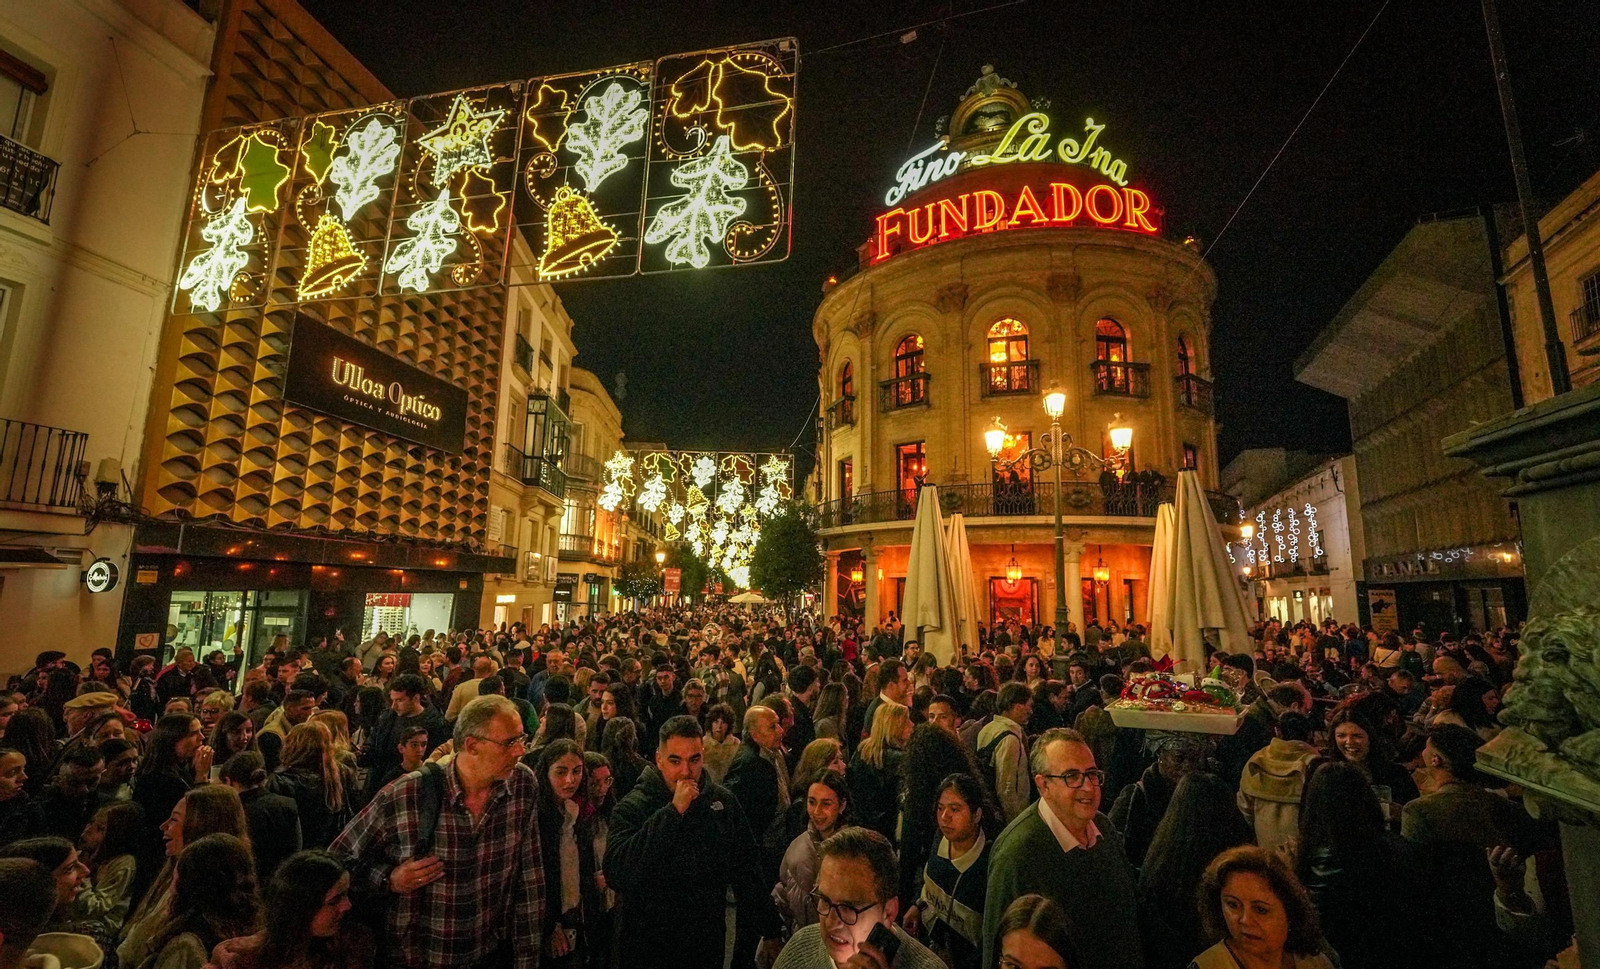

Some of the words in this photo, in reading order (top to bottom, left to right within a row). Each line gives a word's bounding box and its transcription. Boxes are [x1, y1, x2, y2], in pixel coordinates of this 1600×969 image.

[885, 140, 967, 206] Fino
[971, 112, 1053, 165] La
[875, 182, 1158, 260] FUNDADOR
[331, 355, 386, 400] Ulloa
[388, 381, 443, 422] Optico
[343, 393, 375, 411] ÓPTICA
[385, 410, 429, 430] AUDIOLOGÍA
